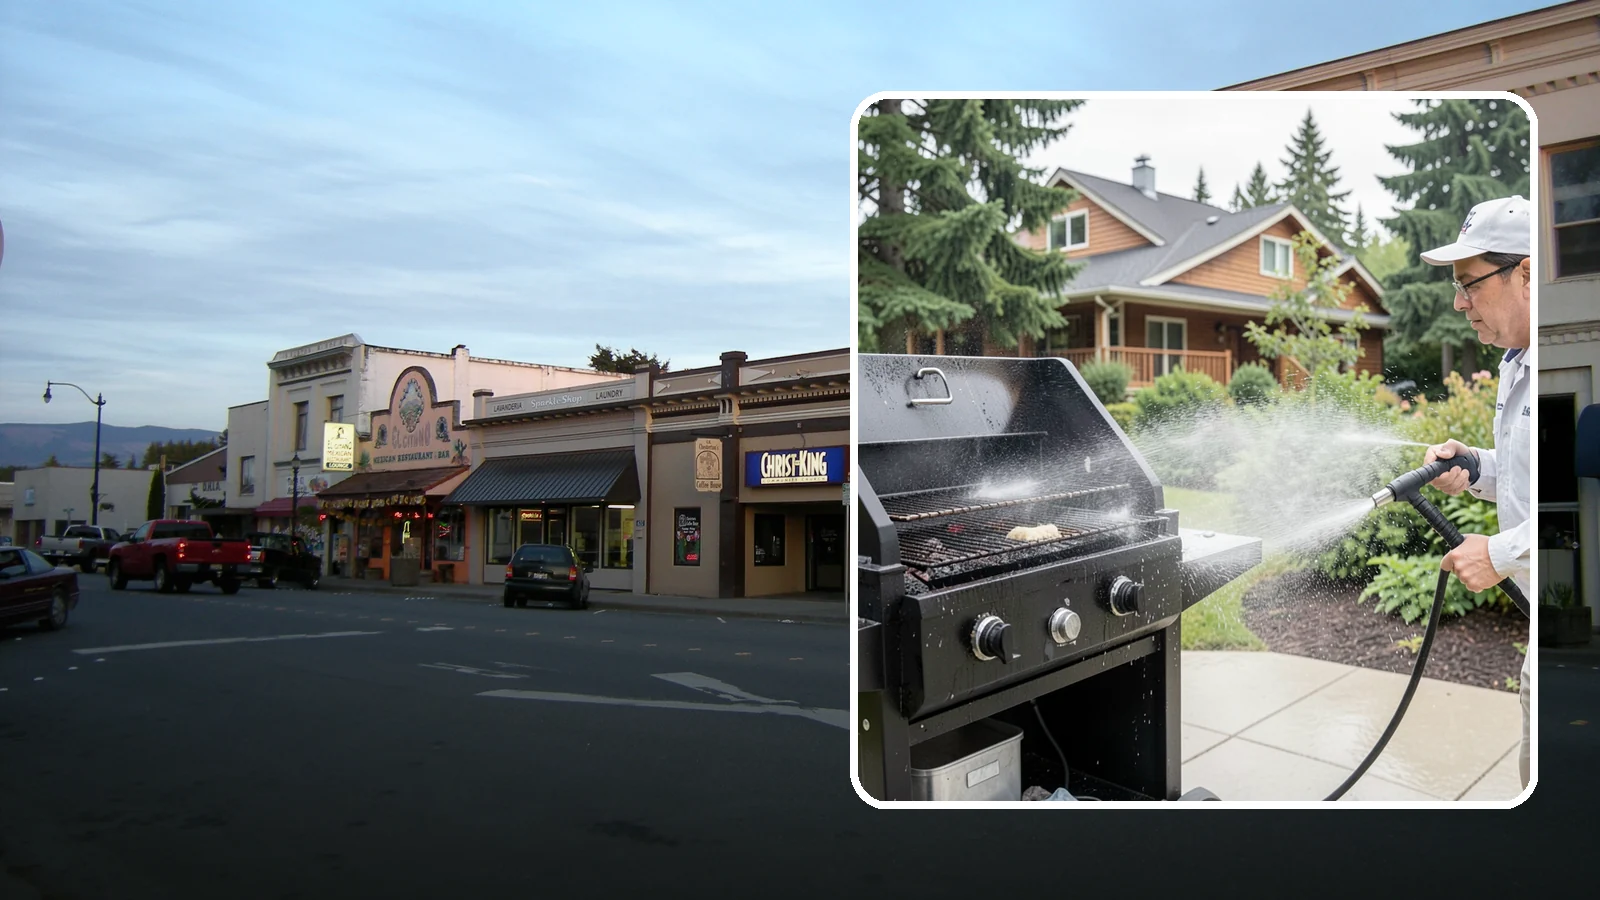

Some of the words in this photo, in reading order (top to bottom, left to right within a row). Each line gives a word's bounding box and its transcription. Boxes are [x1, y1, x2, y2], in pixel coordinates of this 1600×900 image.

[494, 402, 523, 413] LAVANDERIA
[530, 398, 561, 409] Sparkle
[562, 394, 583, 405] Shop
[595, 389, 624, 400] LAUNDRY
[373, 454, 396, 464] MEXICAN
[397, 451, 433, 462] RESTAURANT
[438, 450, 450, 459] BAR
[799, 450, 827, 476] KING
[696, 480, 709, 489] Coffee
[710, 480, 722, 489] House
